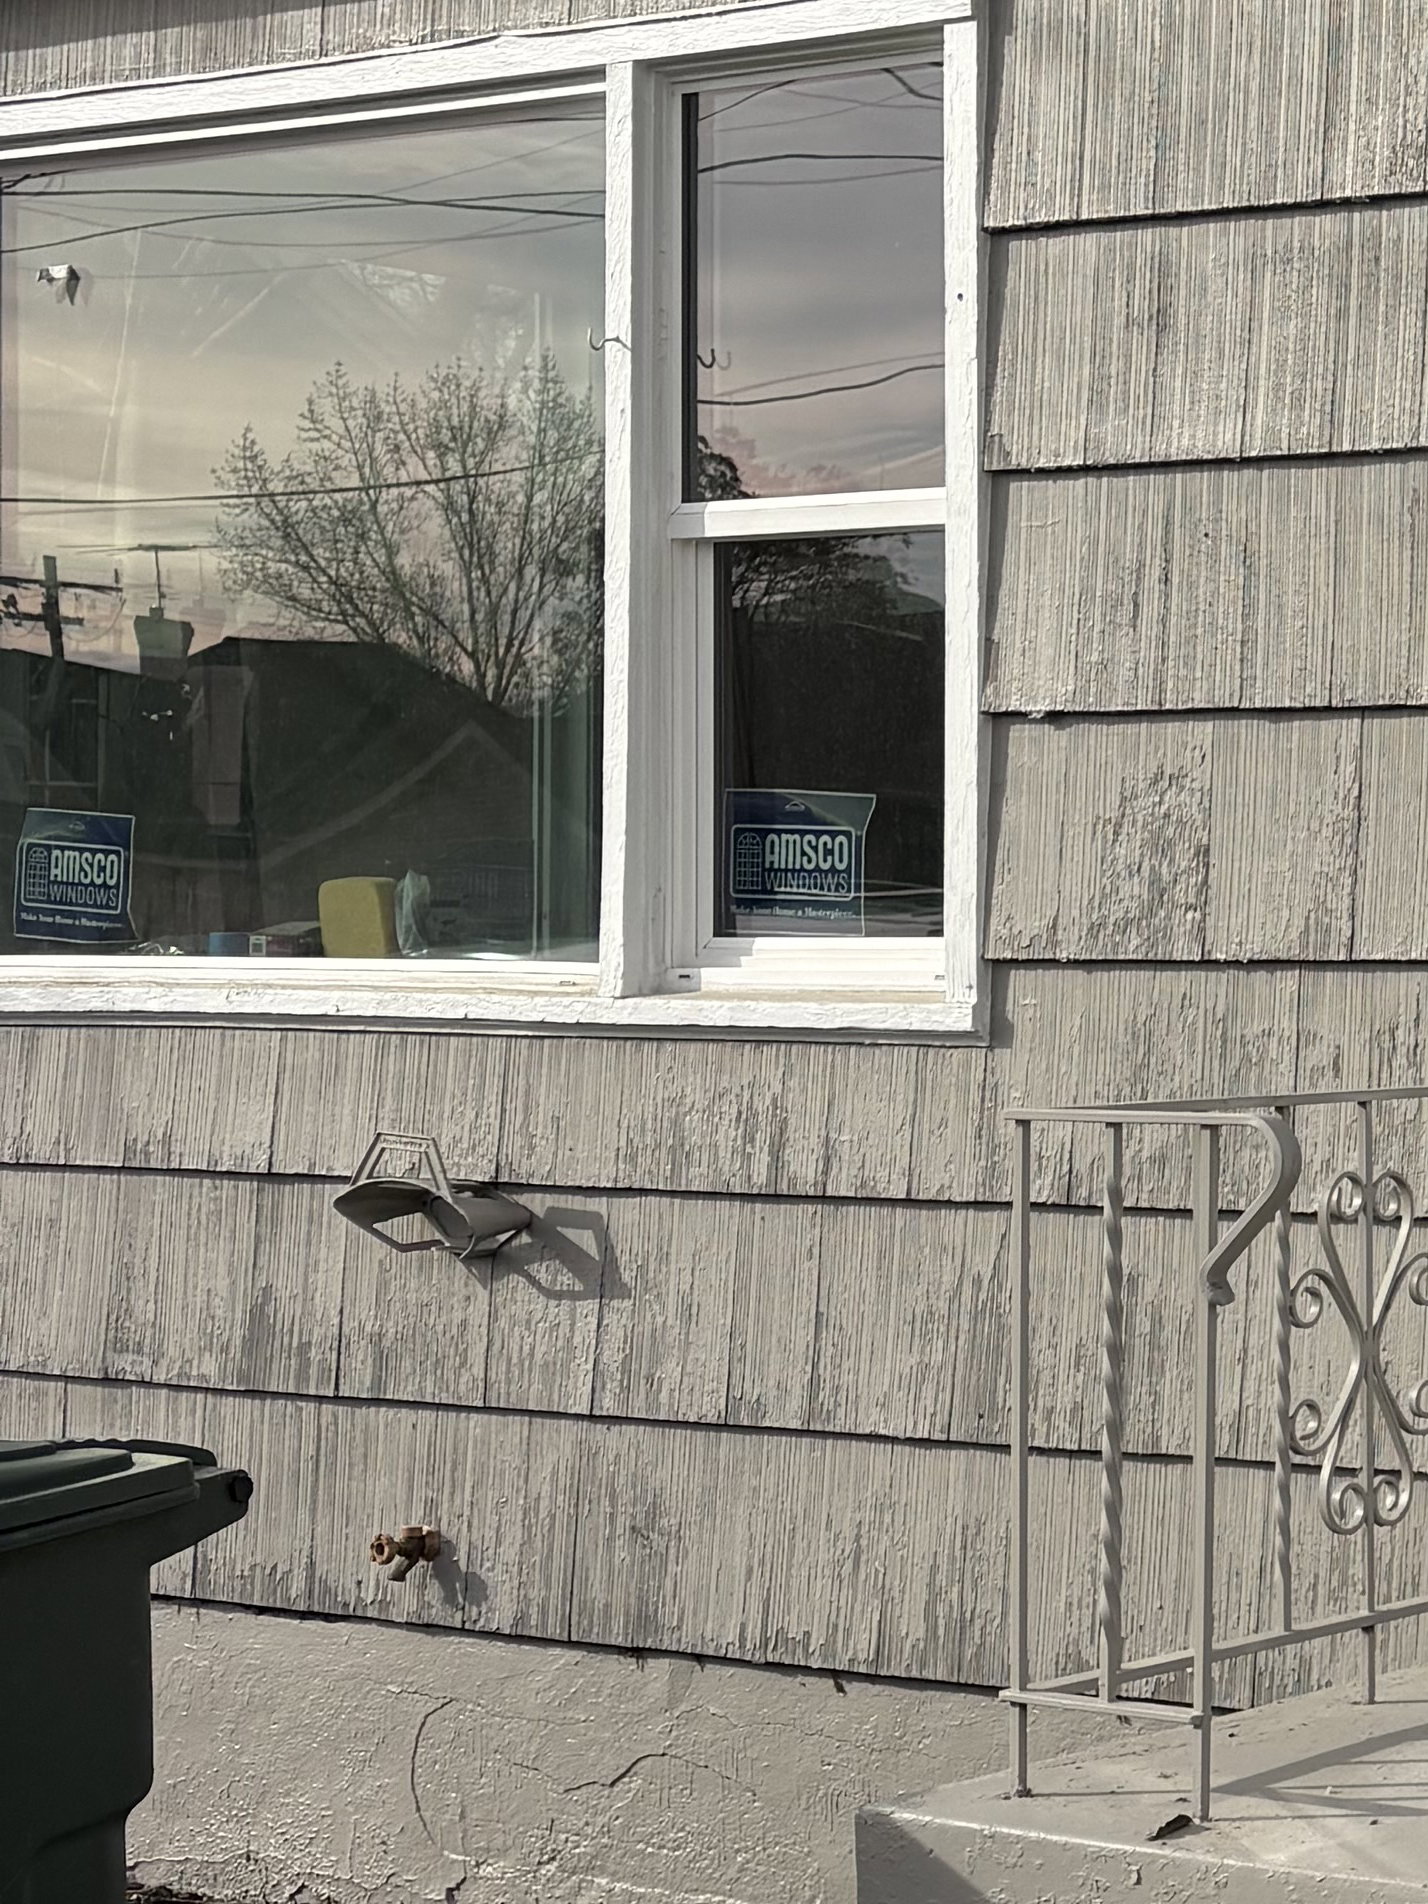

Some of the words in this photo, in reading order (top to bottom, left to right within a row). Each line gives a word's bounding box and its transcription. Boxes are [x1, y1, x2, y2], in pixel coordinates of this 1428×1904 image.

[765, 833, 849, 871] AMSCO
[50, 849, 119, 886] AMSCO
[764, 870, 849, 894] WINDOWS
[50, 883, 118, 907] WINDOWS
